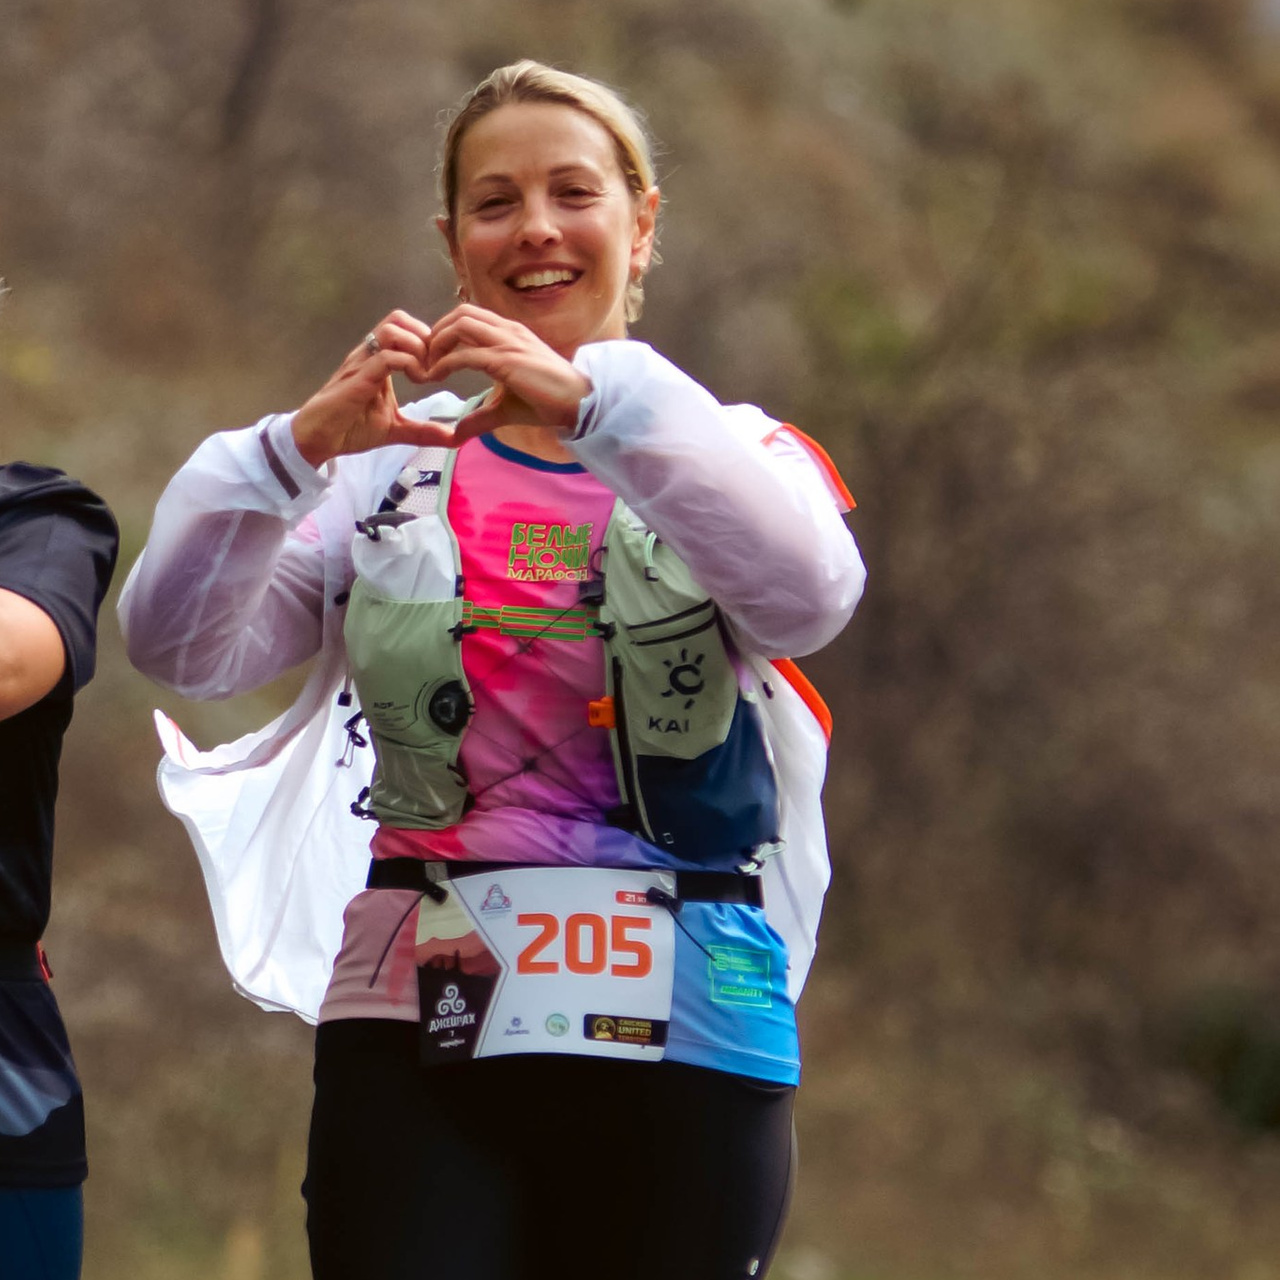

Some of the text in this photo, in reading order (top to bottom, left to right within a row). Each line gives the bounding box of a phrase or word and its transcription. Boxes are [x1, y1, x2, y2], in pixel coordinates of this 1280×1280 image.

[511, 523, 594, 548] БЕЛЫЕ
[508, 545, 590, 570] НОЧИ
[507, 568, 588, 581] МАРАФОН
[648, 715, 690, 734] KAI
[517, 913, 653, 978] 205
[618, 1026, 652, 1036] UNITED
